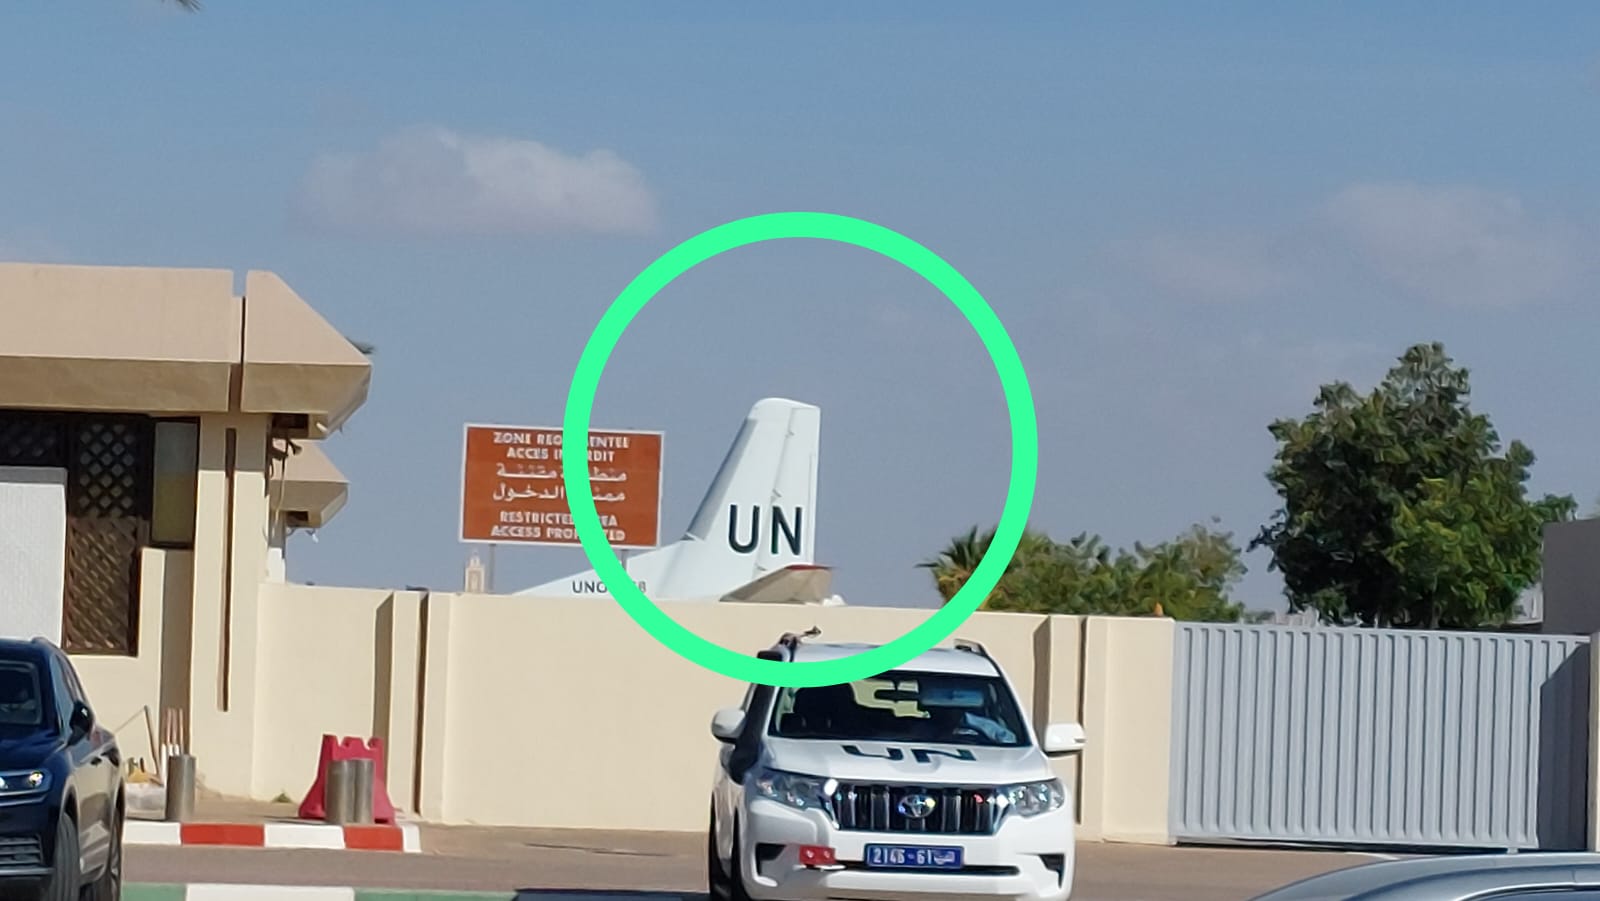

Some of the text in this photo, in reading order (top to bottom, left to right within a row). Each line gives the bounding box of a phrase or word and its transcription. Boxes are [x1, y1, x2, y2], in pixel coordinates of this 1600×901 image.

[493, 431, 630, 449] ZONE REGENTEE
[506, 446, 548, 460] ACCES
[492, 482, 565, 502] الدخول
[491, 524, 541, 538] ACCESS
[728, 504, 803, 556] UN
[841, 744, 978, 763] UN
